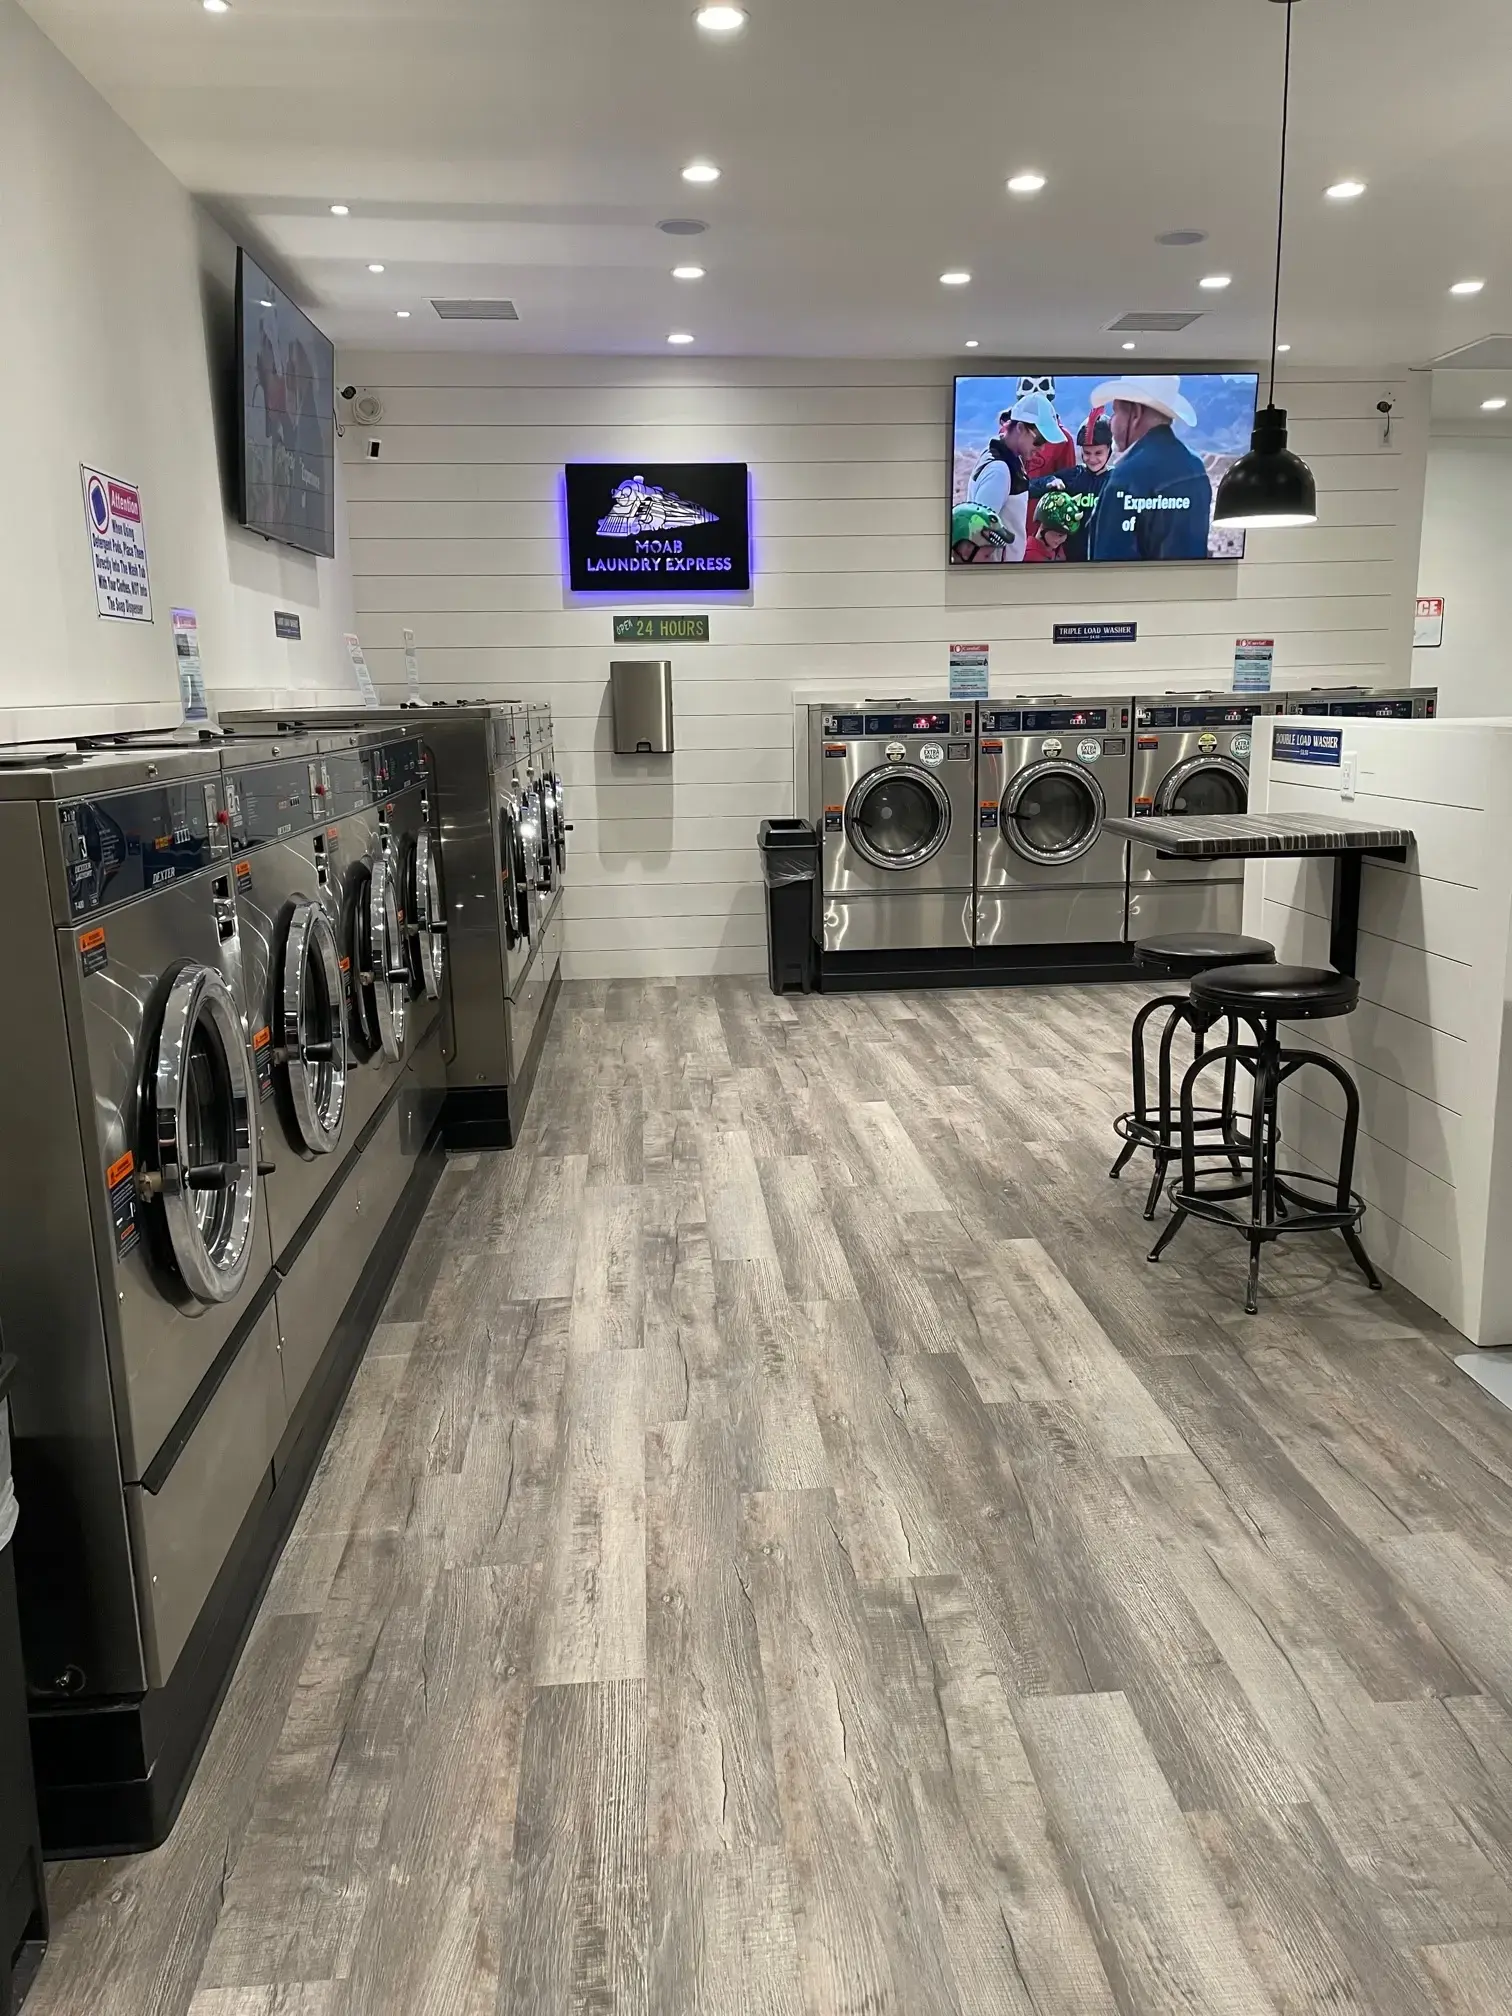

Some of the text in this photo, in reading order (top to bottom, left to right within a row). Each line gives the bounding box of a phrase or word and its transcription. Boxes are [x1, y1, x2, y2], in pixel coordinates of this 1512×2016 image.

[111, 489, 138, 515] Attention
[1121, 516, 1136, 531] of
[635, 540, 683, 554] MOAB
[587, 557, 732, 572] LAUNDRY EXPRESS
[616, 618, 704, 636] OPEN 24 HOURS
[1059, 627, 1082, 635] TRIPLE
[1103, 626, 1131, 634] WASHER
[1275, 733, 1338, 749] DOUBLE LOAD WASHER
[152, 866, 176, 885] DEXTER
